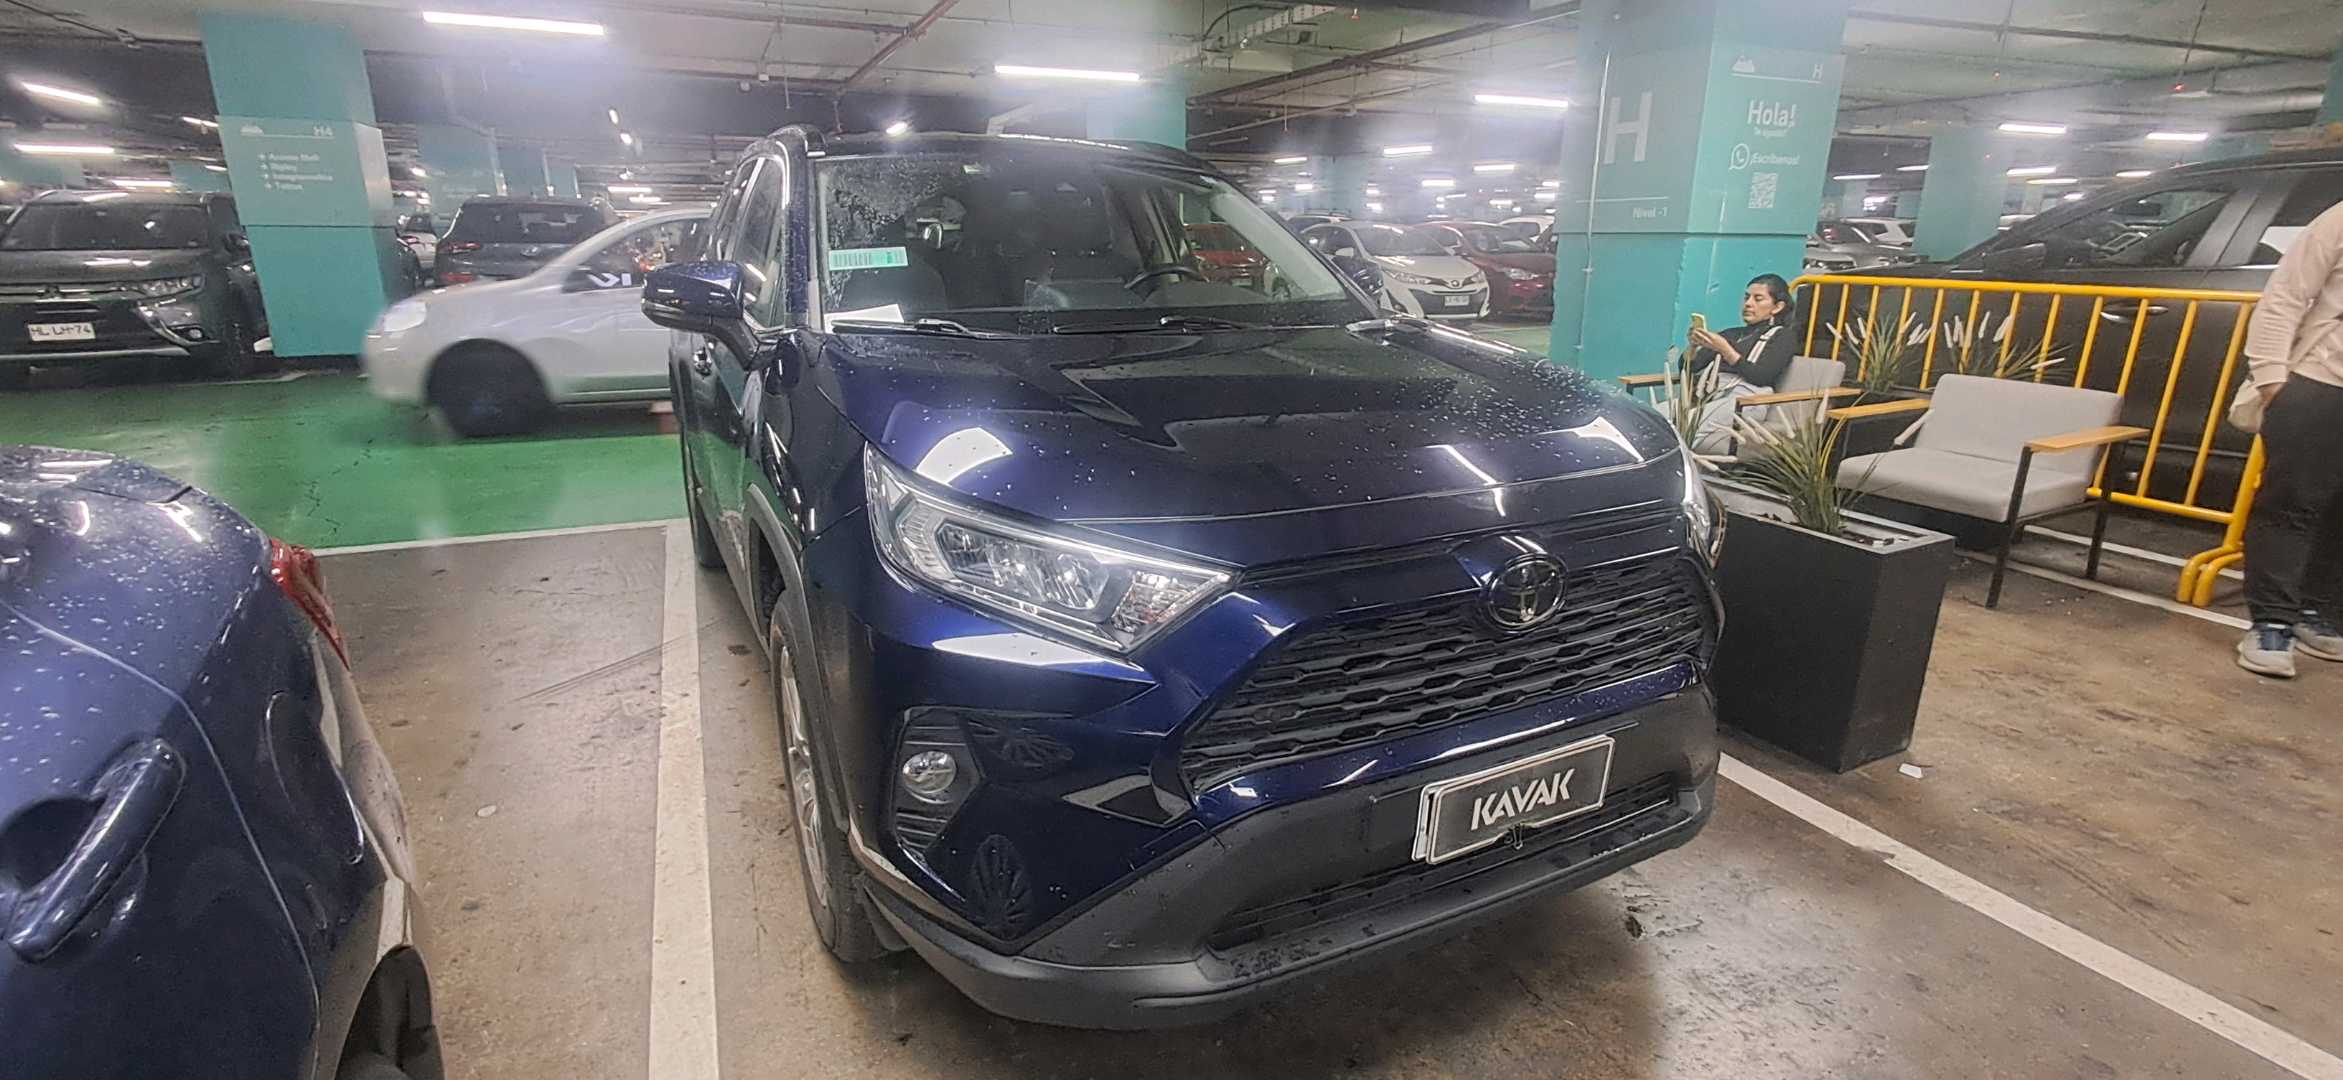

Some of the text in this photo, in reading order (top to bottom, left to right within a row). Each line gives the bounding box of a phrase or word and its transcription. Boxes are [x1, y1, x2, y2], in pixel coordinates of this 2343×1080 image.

[1812, 64, 1824, 79] H
[1604, 91, 1653, 165] H
[1747, 100, 1797, 128] Hola!
[1471, 768, 1575, 831] KAVAK
